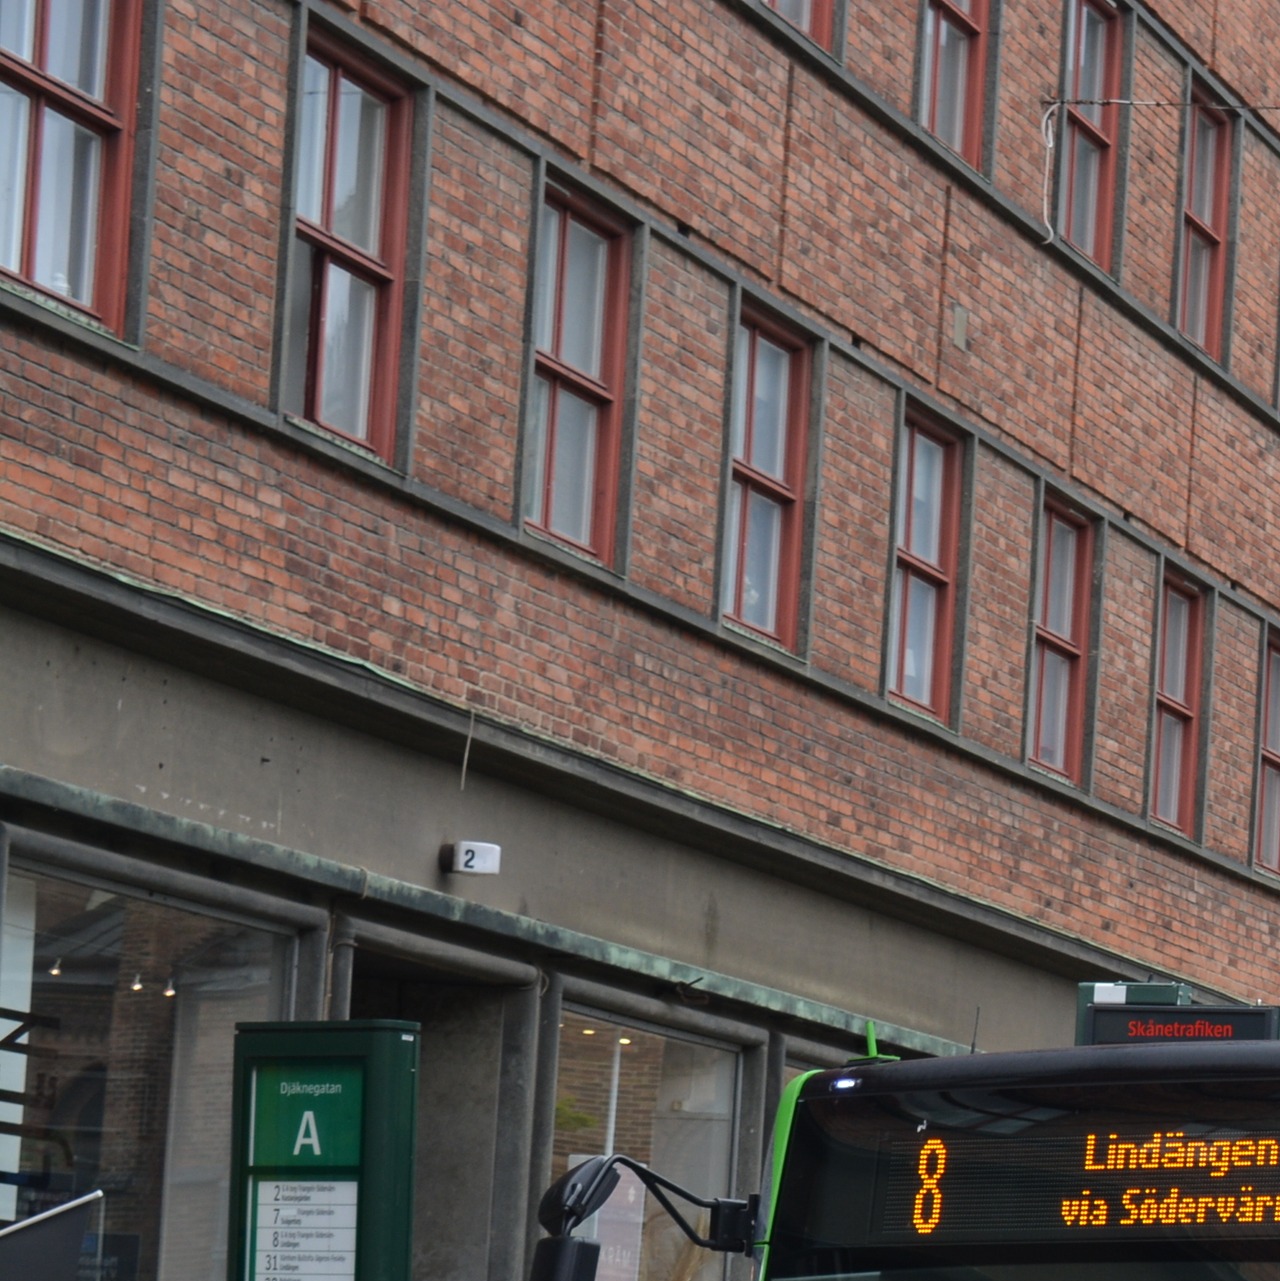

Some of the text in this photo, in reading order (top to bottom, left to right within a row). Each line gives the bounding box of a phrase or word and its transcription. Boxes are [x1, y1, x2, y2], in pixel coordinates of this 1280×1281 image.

[464, 849, 475, 869] 2
[1127, 1018, 1233, 1038] Skånetrafiken
[280, 1082, 342, 1097] Djäknegatan
[293, 1110, 321, 1156] A
[1084, 1132, 1280, 1177] Lindängen
[273, 1185, 280, 1202] 2
[912, 1138, 947, 1234] 8
[273, 1208, 280, 1225] 7
[1061, 1189, 1108, 1226] via
[272, 1231, 279, 1248] 8
[265, 1254, 278, 1271] 31
